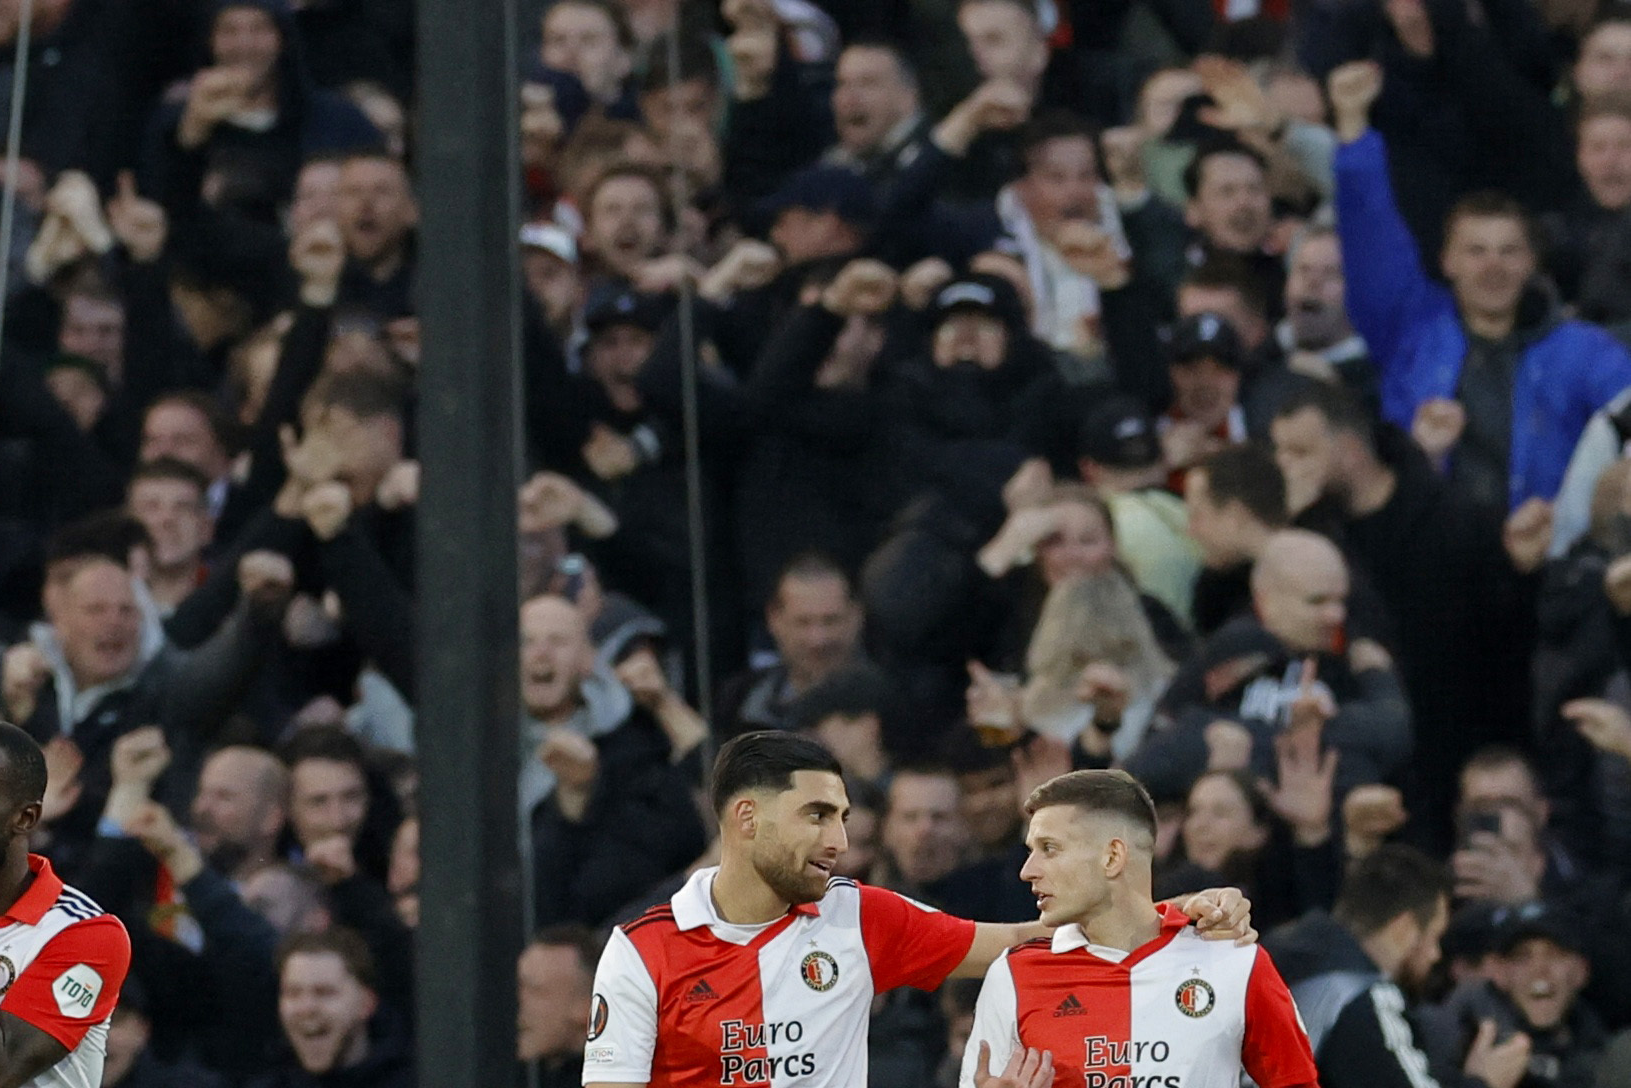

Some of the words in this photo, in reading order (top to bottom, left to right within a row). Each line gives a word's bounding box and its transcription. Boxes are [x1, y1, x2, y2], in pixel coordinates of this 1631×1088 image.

[60, 975, 94, 1008] TOTO
[720, 1018, 804, 1053] Euro
[720, 1051, 816, 1085] Parcs
[1084, 1035, 1170, 1071] Euro
